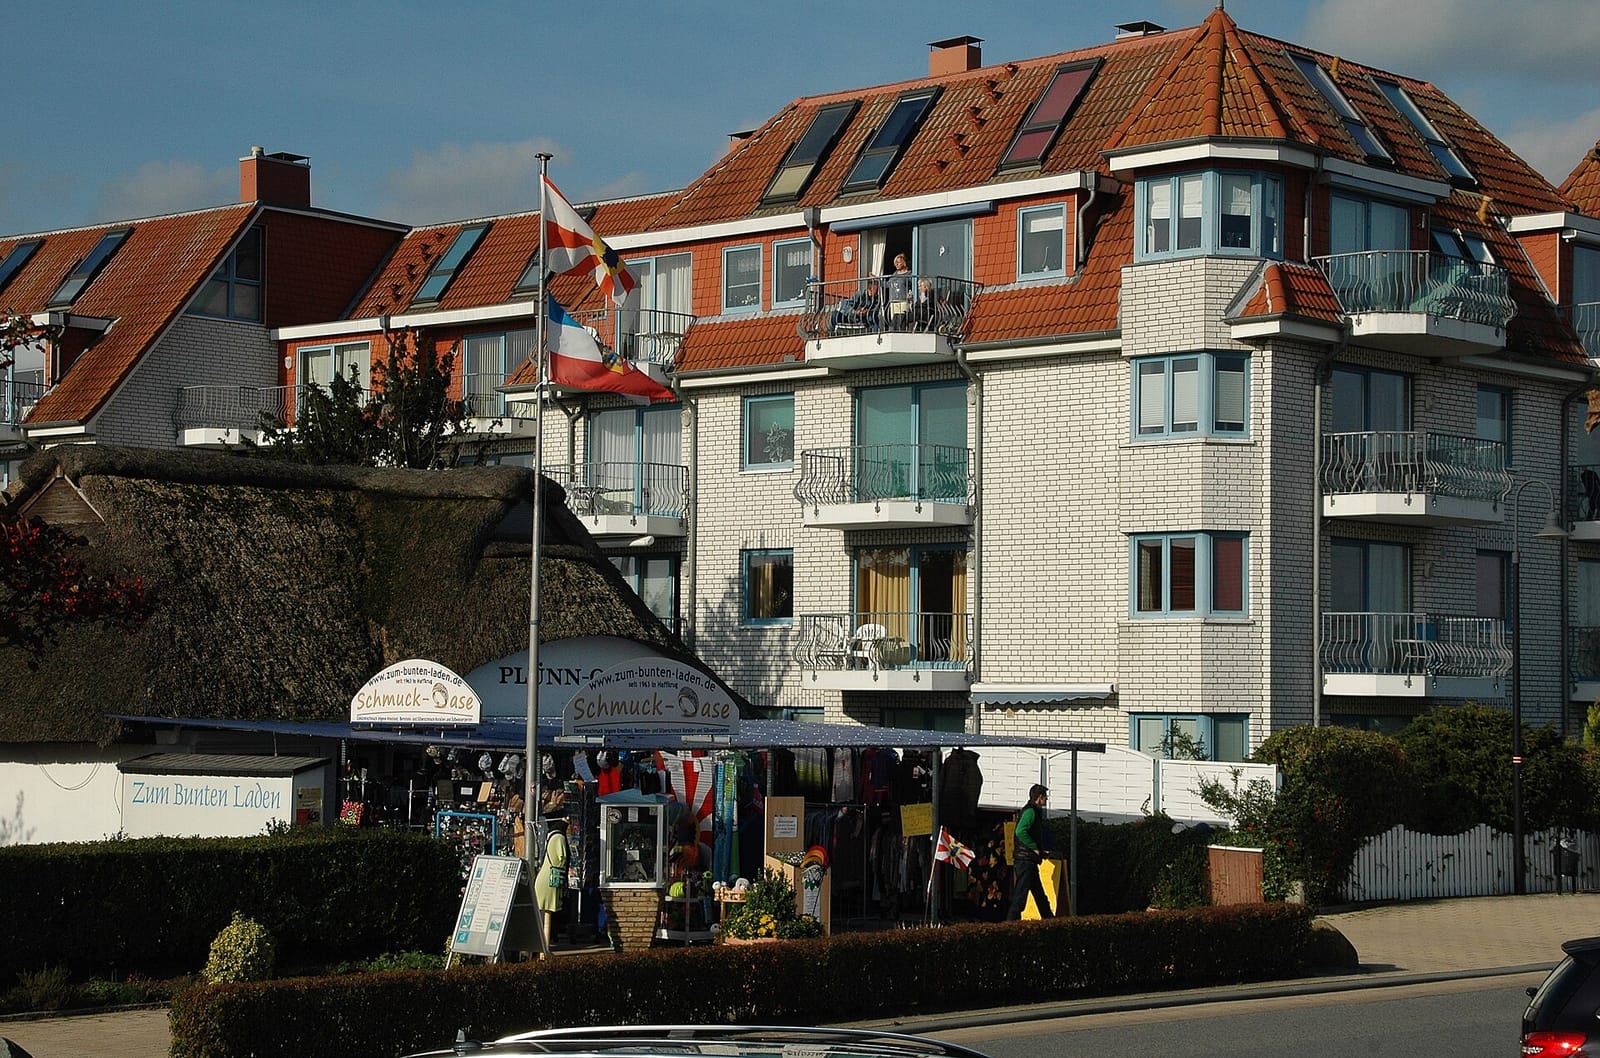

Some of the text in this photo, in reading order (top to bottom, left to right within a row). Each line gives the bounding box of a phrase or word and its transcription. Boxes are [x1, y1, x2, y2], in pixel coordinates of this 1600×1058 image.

[368, 667, 462, 687] www.zum-bunten-laden.de
[589, 666, 716, 692] www.zum-bunten-laden.de
[132, 782, 281, 809] Zum Bunten Laden
